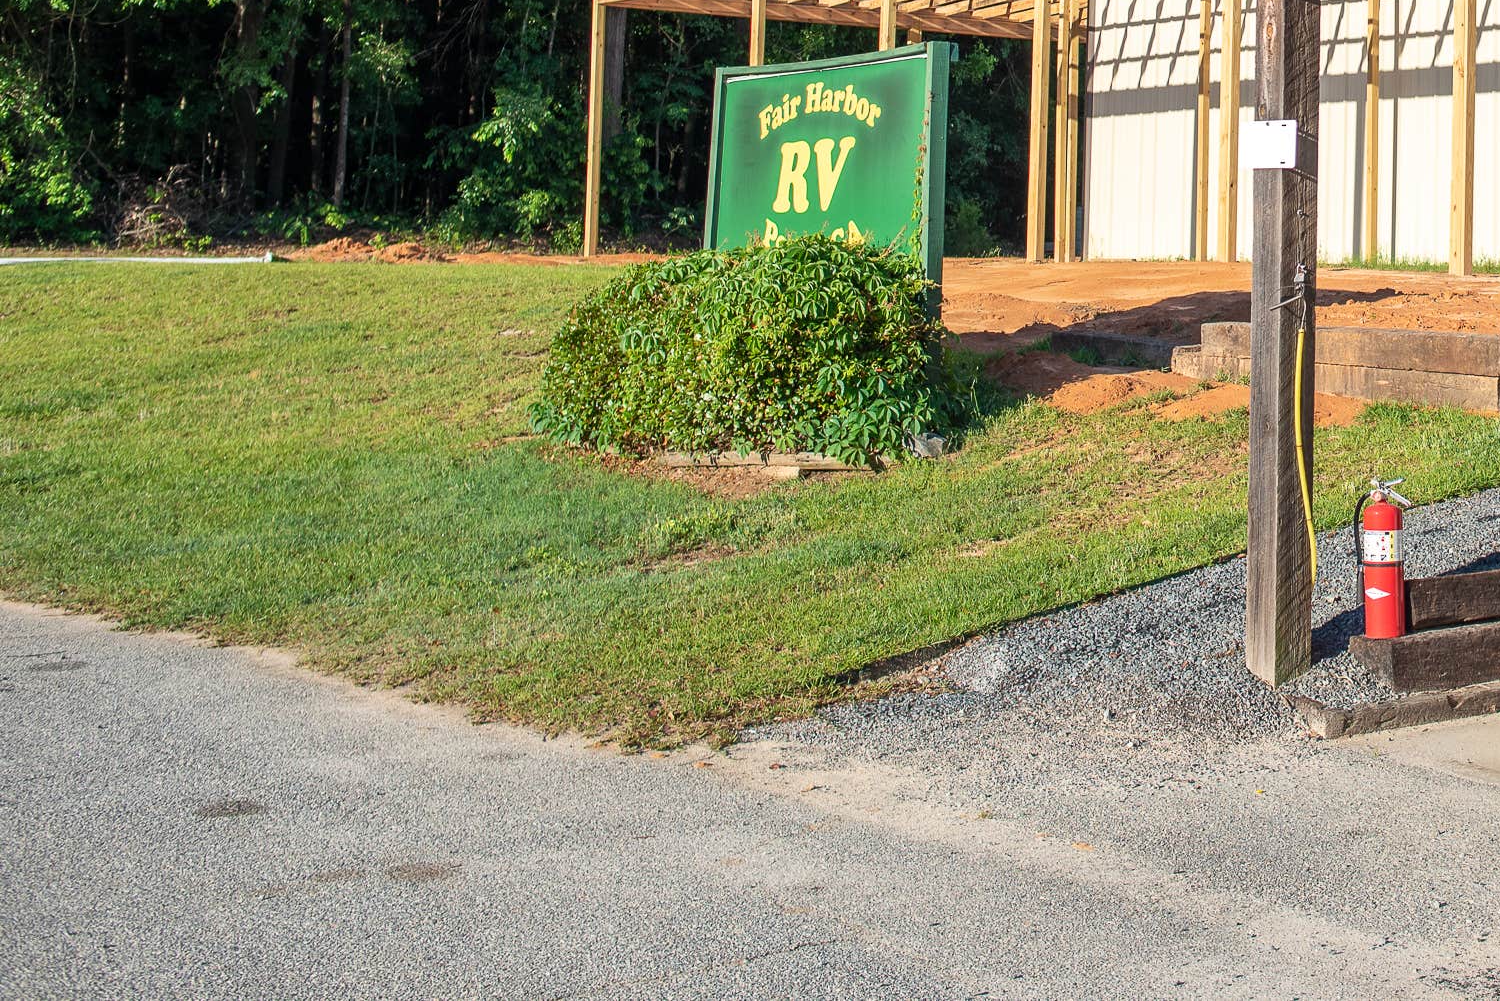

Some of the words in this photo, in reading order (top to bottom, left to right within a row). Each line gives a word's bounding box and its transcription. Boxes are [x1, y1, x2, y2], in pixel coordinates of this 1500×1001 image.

[758, 93, 802, 140] Fair
[805, 82, 882, 128] Harbor
[772, 136, 857, 213] RV
